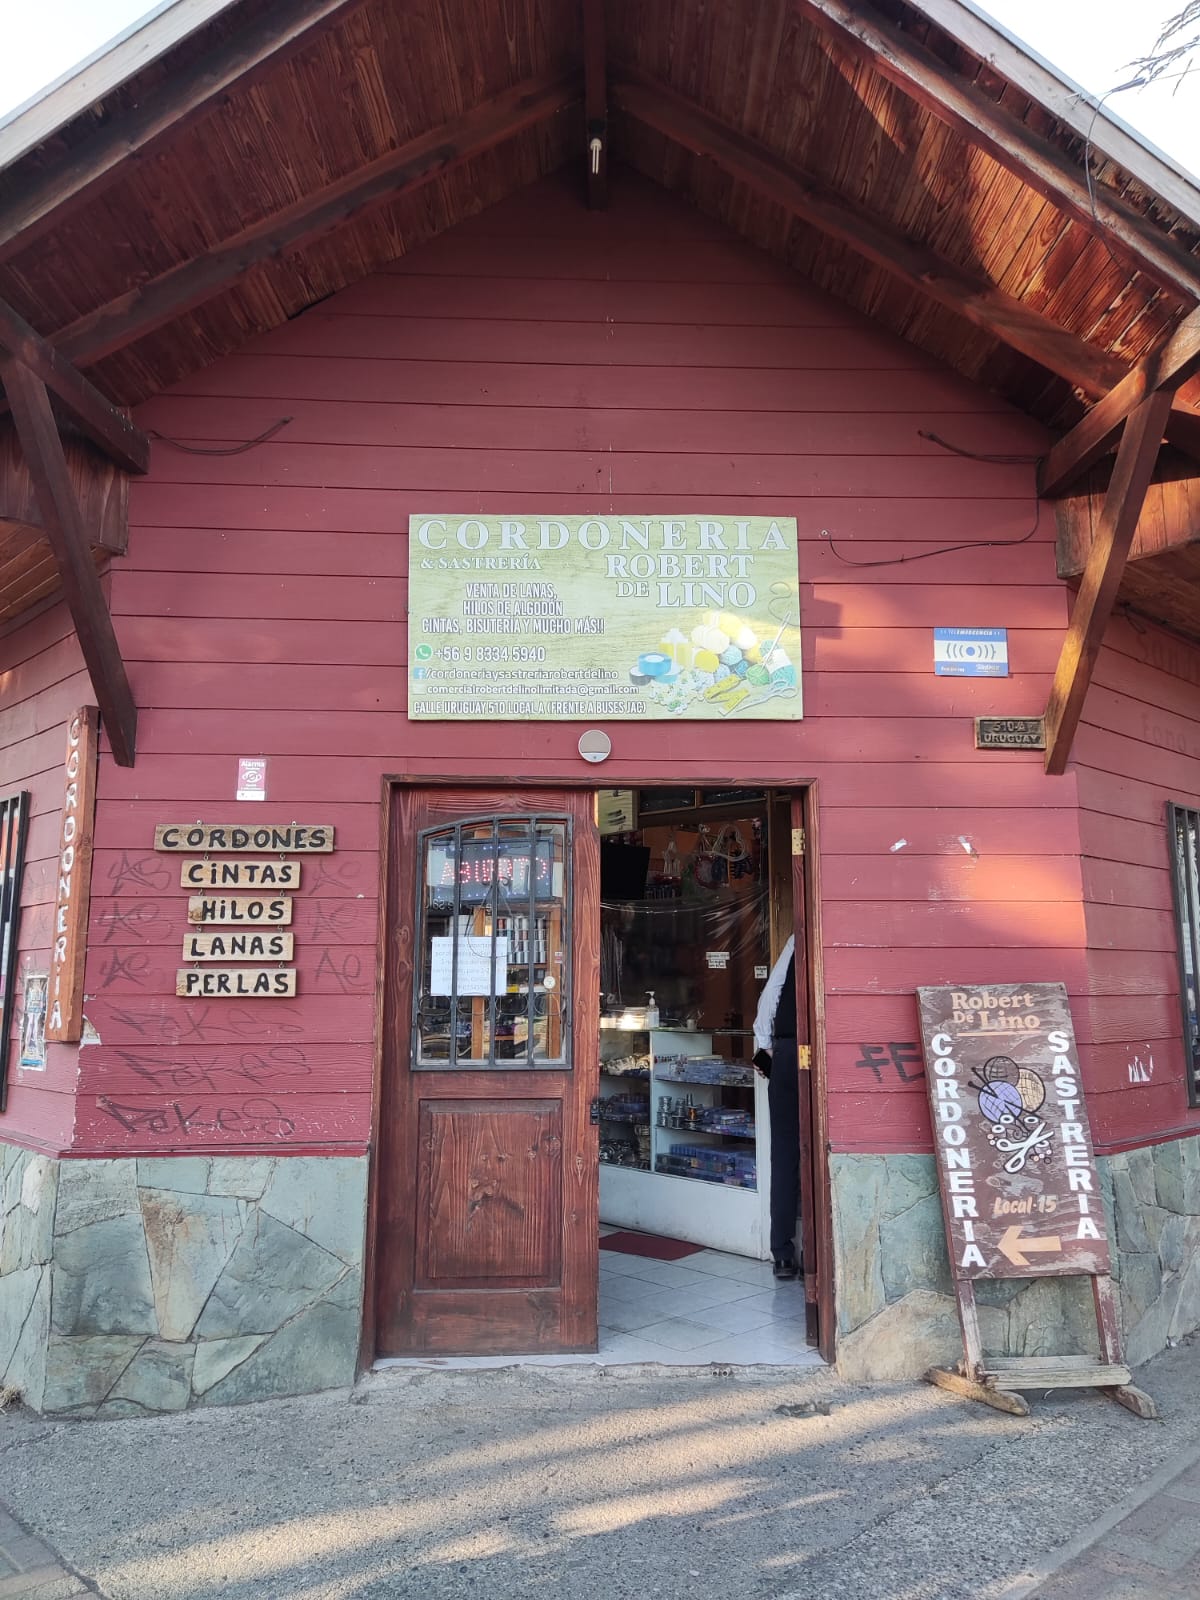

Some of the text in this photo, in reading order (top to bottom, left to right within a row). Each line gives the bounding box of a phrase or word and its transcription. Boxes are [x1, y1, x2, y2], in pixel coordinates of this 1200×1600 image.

[418, 520, 790, 550] CORDONERIA
[420, 553, 542, 570] & SASTRERÍA
[605, 554, 754, 578] ROBERT
[466, 583, 557, 601] VENTA DE LANAS,
[616, 581, 757, 608] DE LINO
[463, 599, 563, 617] HILOS DE ALGODÓN
[422, 618, 463, 634] CINTAS,
[523, 618, 534, 634] Y
[534, 618, 571, 634] MUCHO
[574, 616, 605, 634] MÁS!!
[434, 646, 546, 661] +56 9 8334 5940
[414, 702, 442, 715] CALLE
[444, 702, 486, 715] URUGUAY
[488, 702, 505, 714] 510
[508, 702, 537, 715] LOCAL
[547, 702, 585, 715] (FRENTE
[586, 702, 595, 714] A
[596, 702, 624, 715] BUSES
[984, 733, 1040, 744] URUGUAY
[162, 828, 326, 849] CORDONES
[191, 936, 284, 957] LANAS
[186, 973, 289, 994] PERLAS
[951, 991, 1035, 1010] Robert
[953, 1010, 1041, 1030] De Lino
[1047, 1031, 1100, 1239] SASTRERIA
[931, 1033, 988, 1267] CORDONERIA
